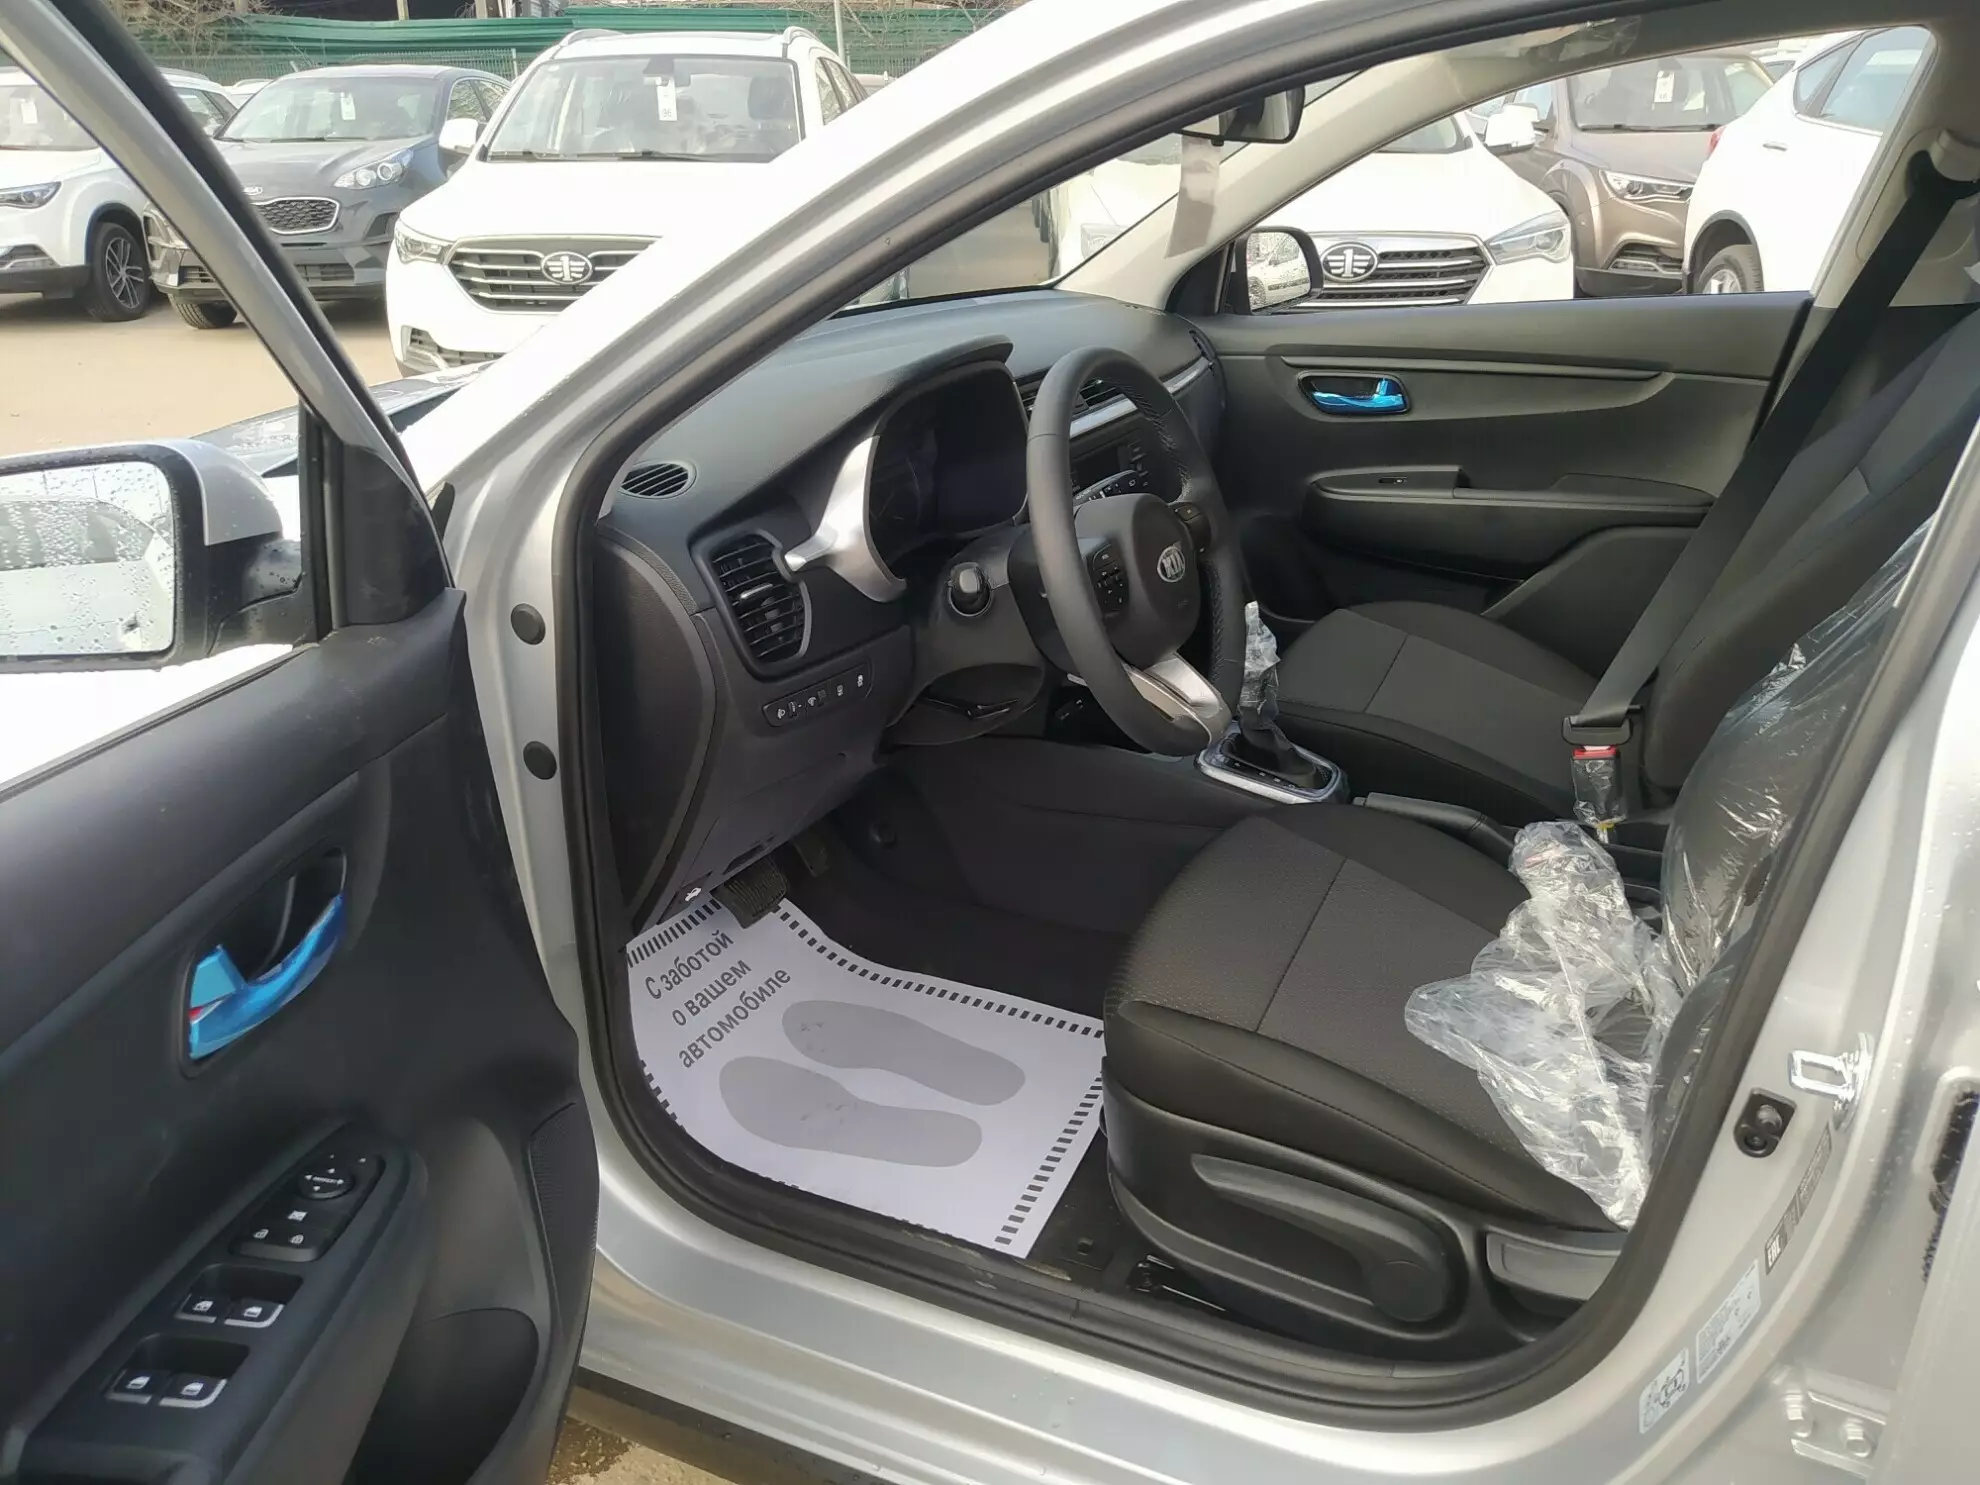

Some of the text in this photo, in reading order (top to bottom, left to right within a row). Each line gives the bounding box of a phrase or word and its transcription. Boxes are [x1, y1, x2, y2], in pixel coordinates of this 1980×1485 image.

[645, 929, 734, 1000] С заботой
[672, 959, 752, 1026] о вашем
[679, 969, 791, 1068] автомобиле
